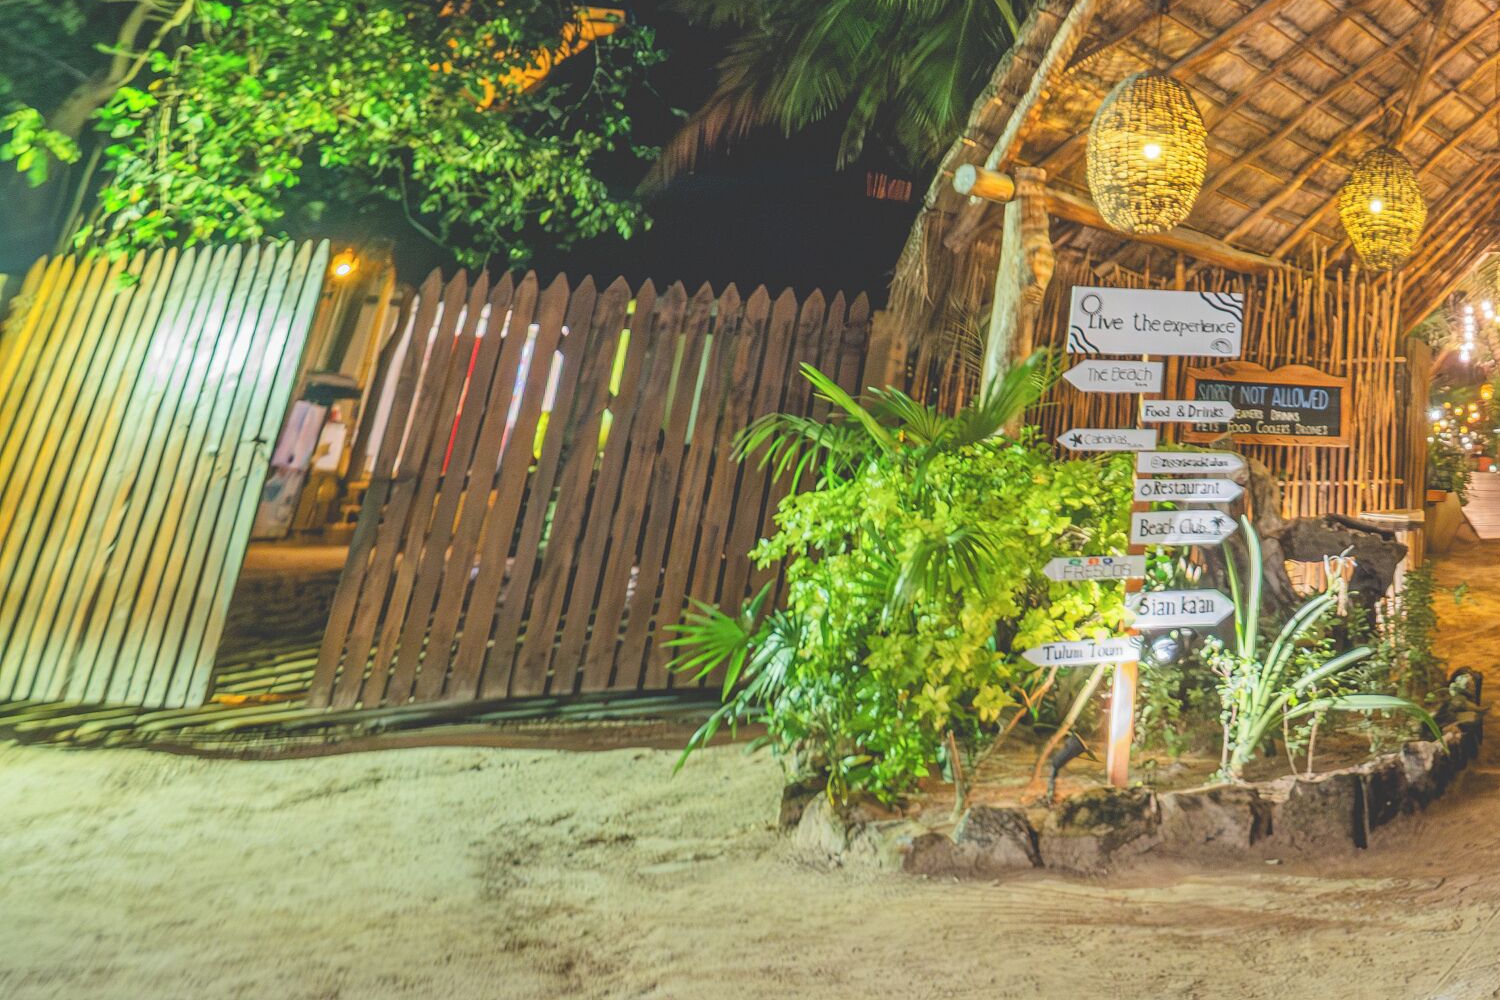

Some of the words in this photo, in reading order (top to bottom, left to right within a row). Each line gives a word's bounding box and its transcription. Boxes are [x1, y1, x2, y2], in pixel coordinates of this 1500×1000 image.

[1088, 312, 1124, 330] Live
[1133, 312, 1164, 333] the
[1163, 318, 1237, 337] experience
[1111, 366, 1152, 382] Beach
[1198, 383, 1234, 401] SORRY
[1240, 386, 1268, 405] NOT
[1271, 387, 1329, 411] ALLOWED
[1145, 405, 1170, 417] Food
[1176, 405, 1185, 417] &
[1270, 408, 1300, 422] DRINKS
[1152, 481, 1220, 495] Restaurant
[1140, 519, 1175, 537] Beach
[1063, 564, 1131, 579] FRESCOS
[1138, 598, 1175, 616] Sian
[1043, 645, 1083, 661] Tulum
